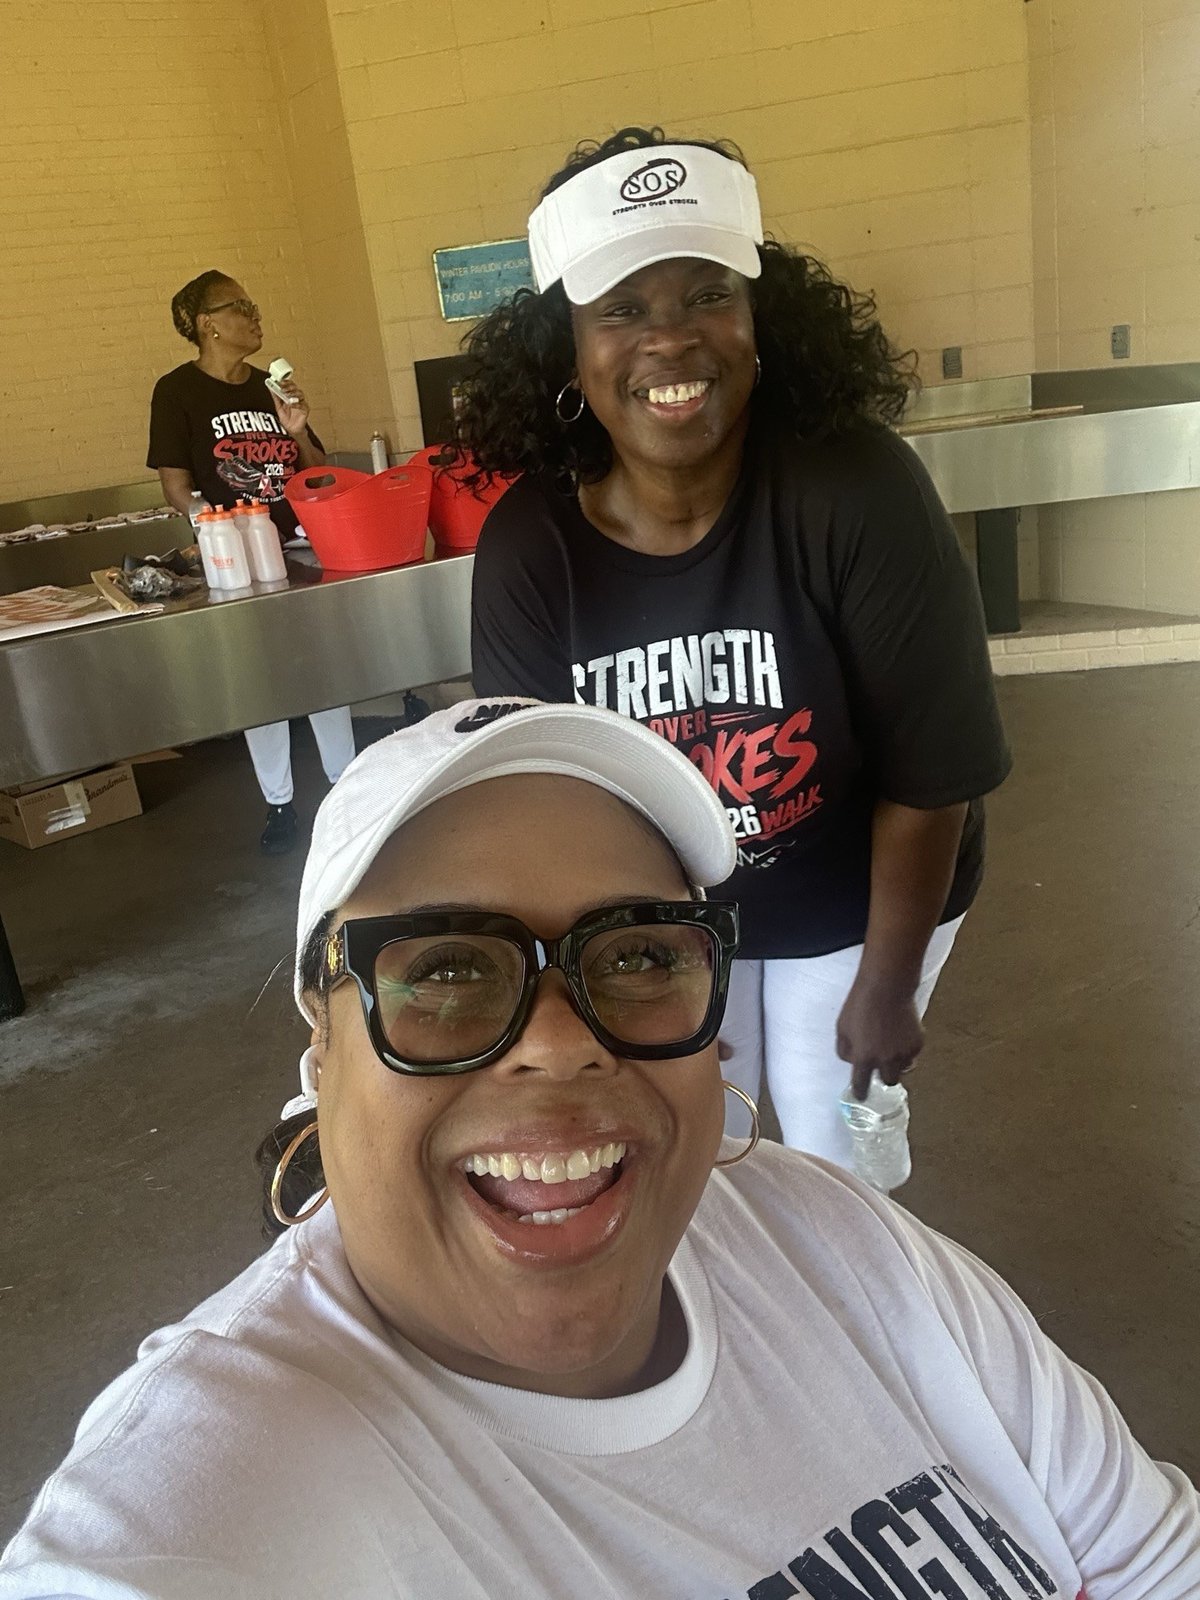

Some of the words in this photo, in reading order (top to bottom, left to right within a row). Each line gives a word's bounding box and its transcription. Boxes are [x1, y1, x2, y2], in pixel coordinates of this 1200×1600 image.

[627, 170, 679, 195] SOS
[612, 203, 647, 216] STRENGTH
[648, 200, 667, 208] OVER
[669, 198, 698, 206] STROKES
[440, 266, 469, 279] WINTER
[470, 261, 501, 275] PAVILION
[444, 291, 465, 304] 7:00
[468, 289, 483, 301] AM
[213, 438, 299, 464] STROKES
[649, 709, 708, 743] OVER
[689, 706, 818, 805] OKES
[725, 804, 762, 838] 26
[760, 783, 823, 833] WALK
